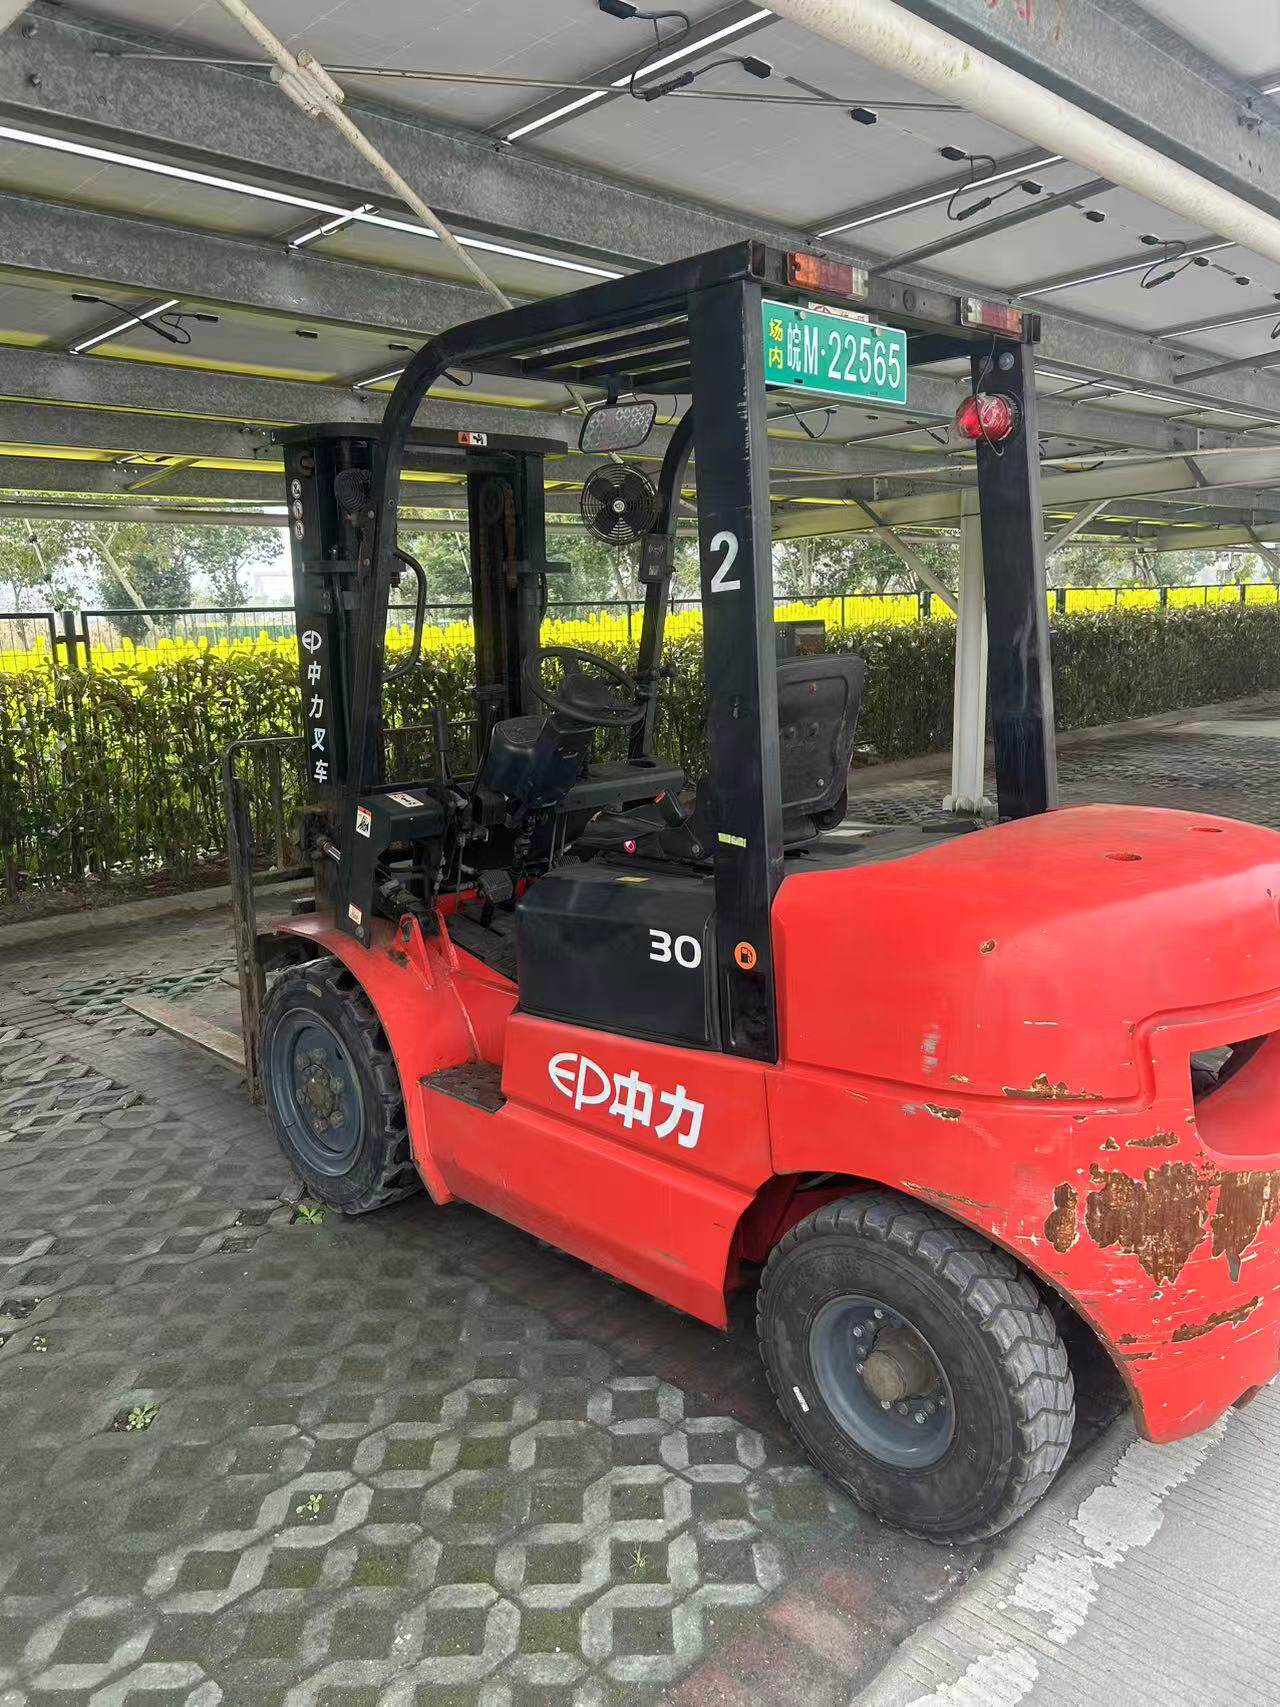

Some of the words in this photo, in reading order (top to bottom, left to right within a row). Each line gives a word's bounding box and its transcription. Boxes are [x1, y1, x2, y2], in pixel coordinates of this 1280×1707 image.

[768, 317, 784, 370] 场内
[709, 530, 741, 594] 2
[648, 929, 702, 969] 30
